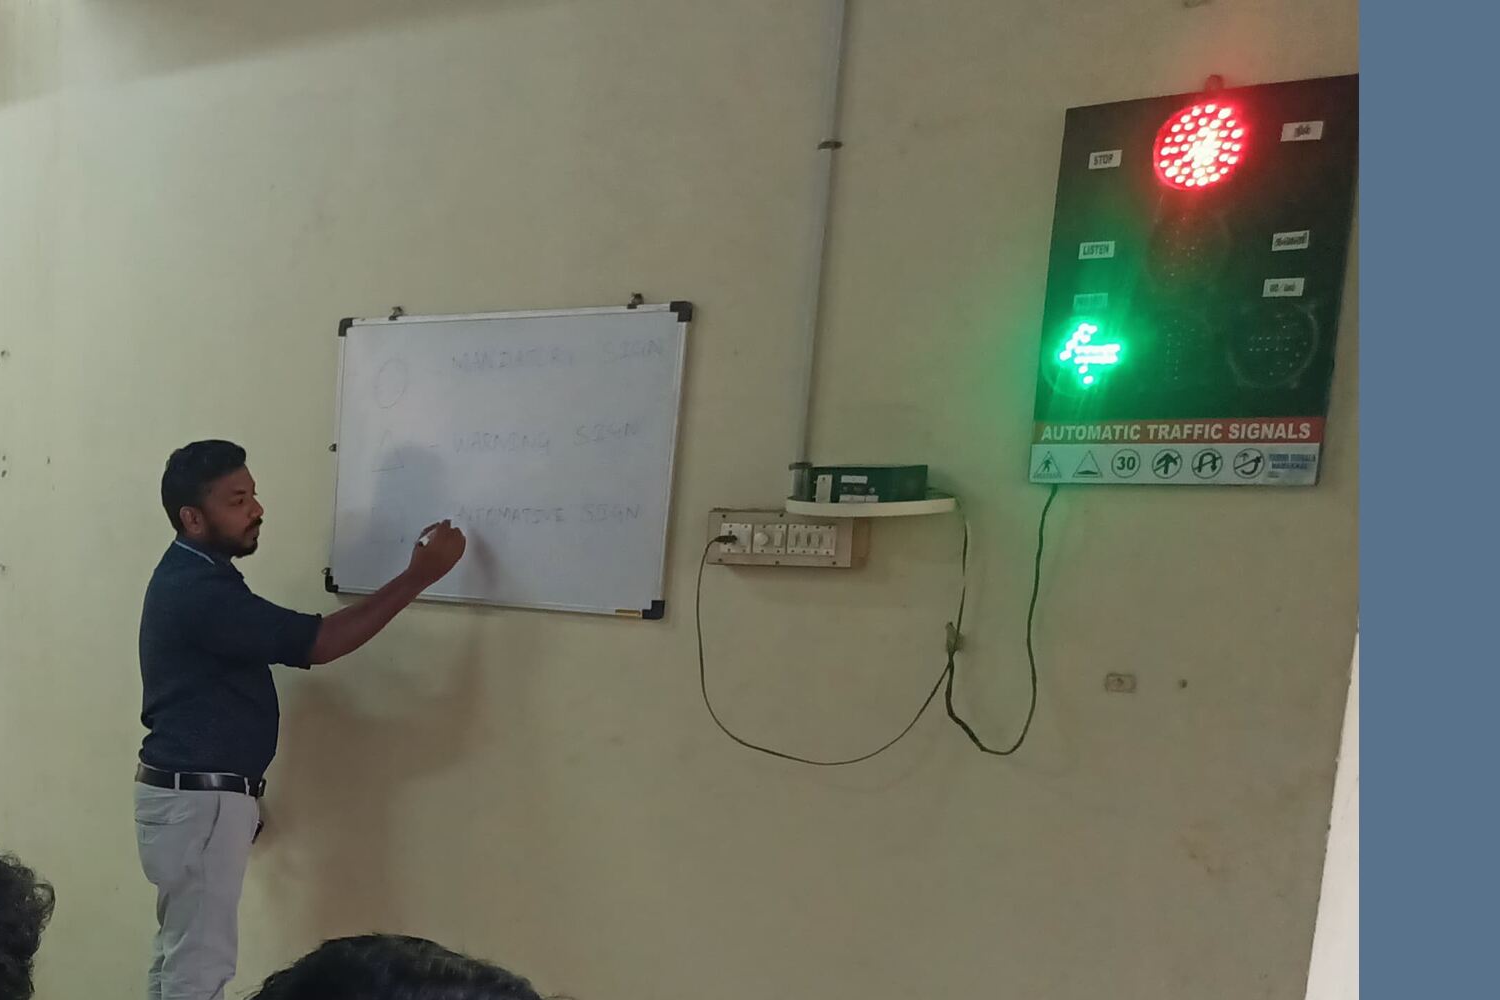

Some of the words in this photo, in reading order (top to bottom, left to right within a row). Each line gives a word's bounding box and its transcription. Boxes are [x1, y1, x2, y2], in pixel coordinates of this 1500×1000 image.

[1041, 424, 1141, 441] AUTOMATIC
[1146, 422, 1223, 440] TRAFFIC
[1228, 422, 1311, 440] SIGNALS
[1116, 456, 1136, 471] 30
